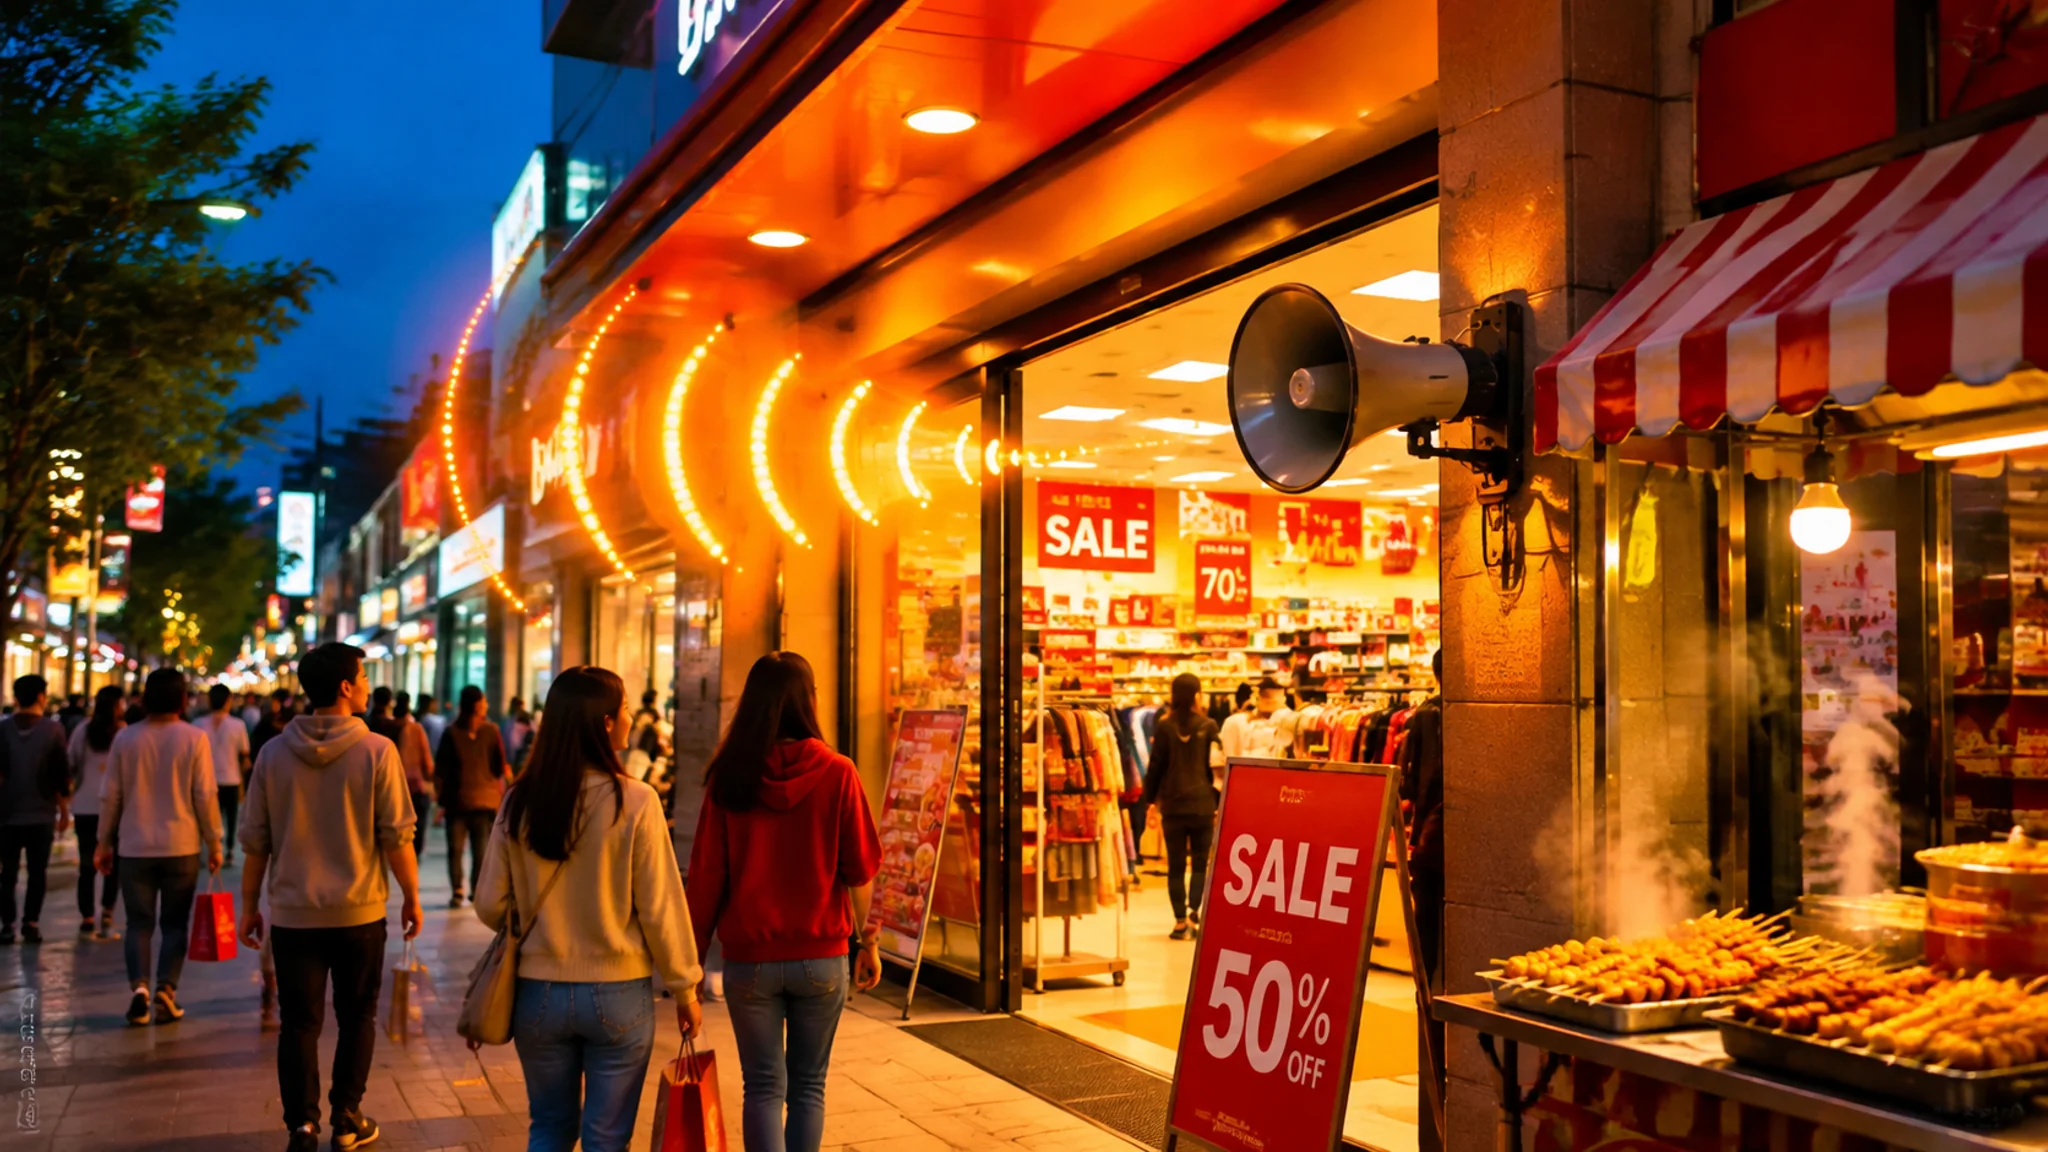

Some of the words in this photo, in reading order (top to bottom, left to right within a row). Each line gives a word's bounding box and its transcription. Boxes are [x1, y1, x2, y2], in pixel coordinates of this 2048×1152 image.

[1045, 514, 1149, 559] SALE
[1223, 833, 1359, 924] SALE
[1202, 948, 1330, 1073] 50%
[1287, 1050, 1326, 1088] OFF
